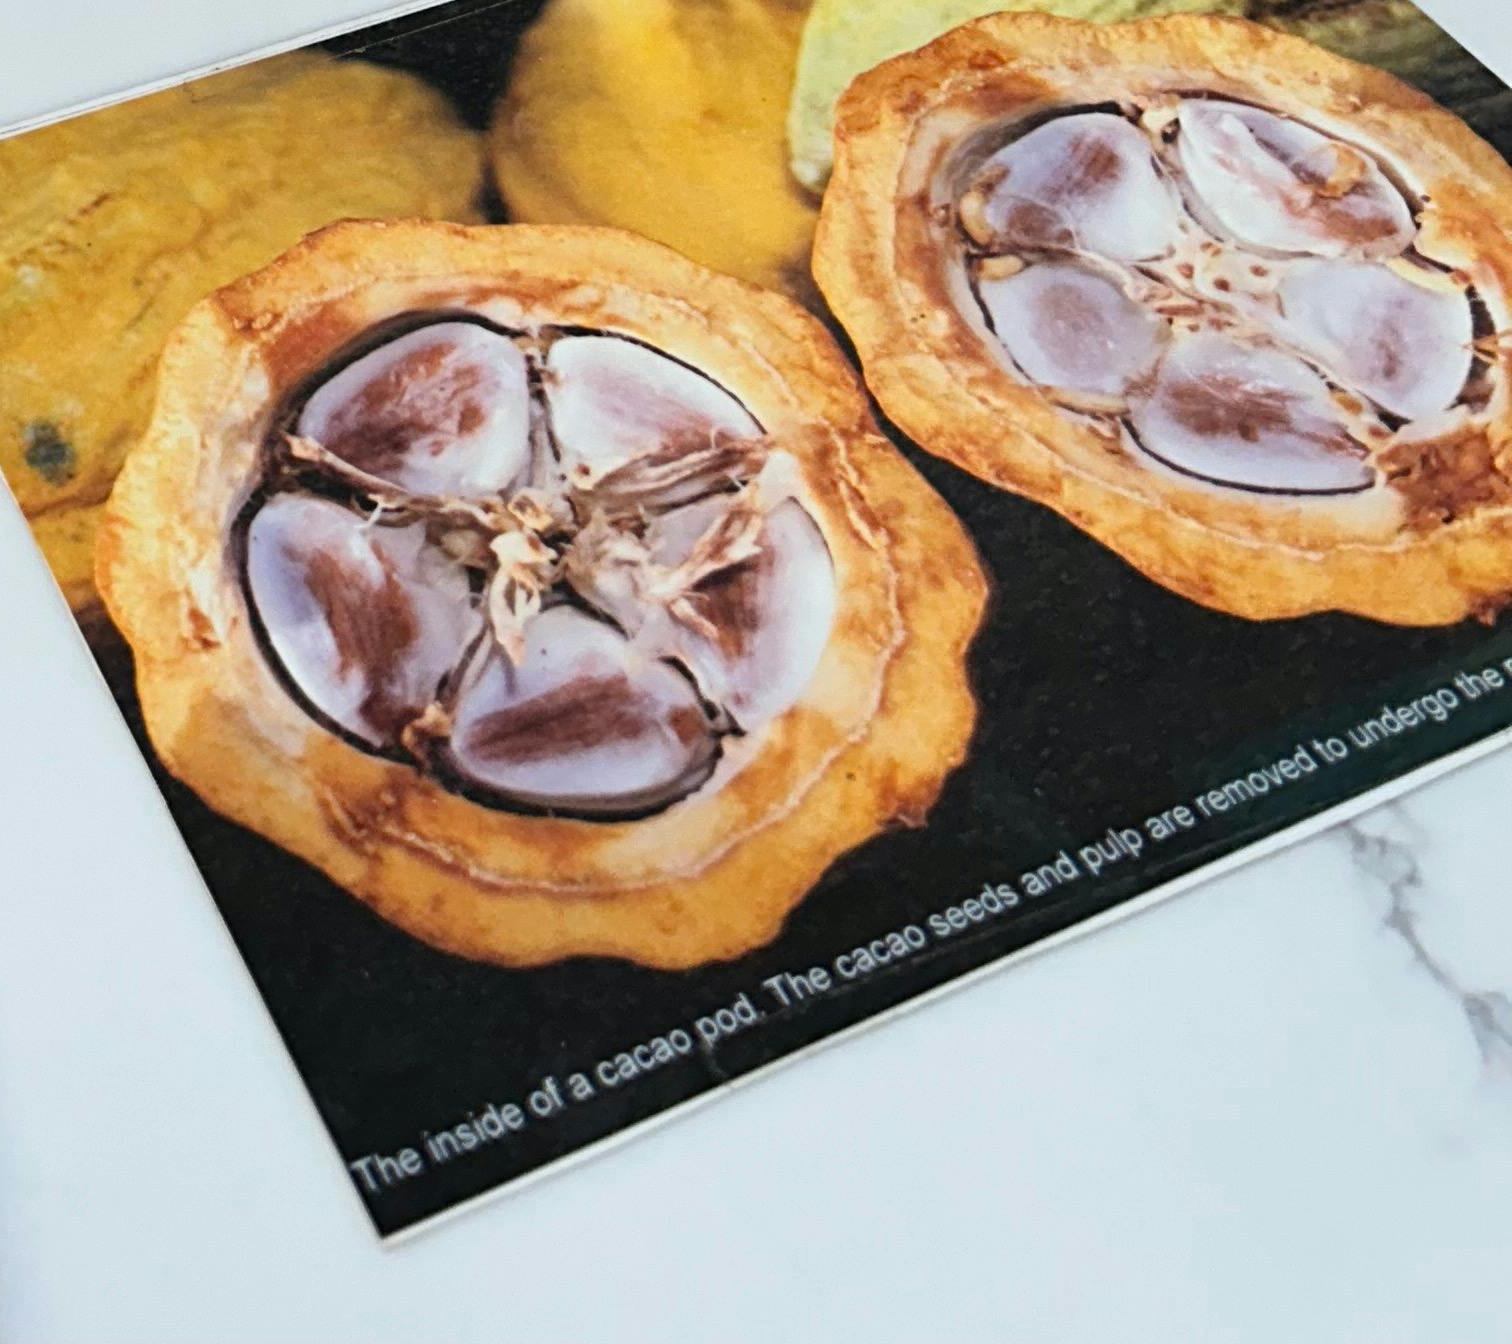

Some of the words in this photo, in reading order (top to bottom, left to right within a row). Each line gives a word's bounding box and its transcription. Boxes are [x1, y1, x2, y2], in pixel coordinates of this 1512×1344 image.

[350, 1145, 424, 1194] The
[423, 1100, 525, 1163] inside
[528, 1075, 567, 1118] of
[567, 1070, 596, 1101] a
[596, 1028, 693, 1087] cacao
[694, 992, 766, 1052] pod.
[763, 966, 832, 1006] The
[835, 923, 926, 979] cacao
[928, 881, 1020, 937] seeds
[1020, 849, 1080, 897] and
[1079, 827, 1144, 877] pulp
[1145, 803, 1196, 842] are
[1195, 743, 1318, 817] removed
[1312, 735, 1349, 764] to
[1348, 686, 1460, 750] undergo
[1453, 668, 1504, 701] the
